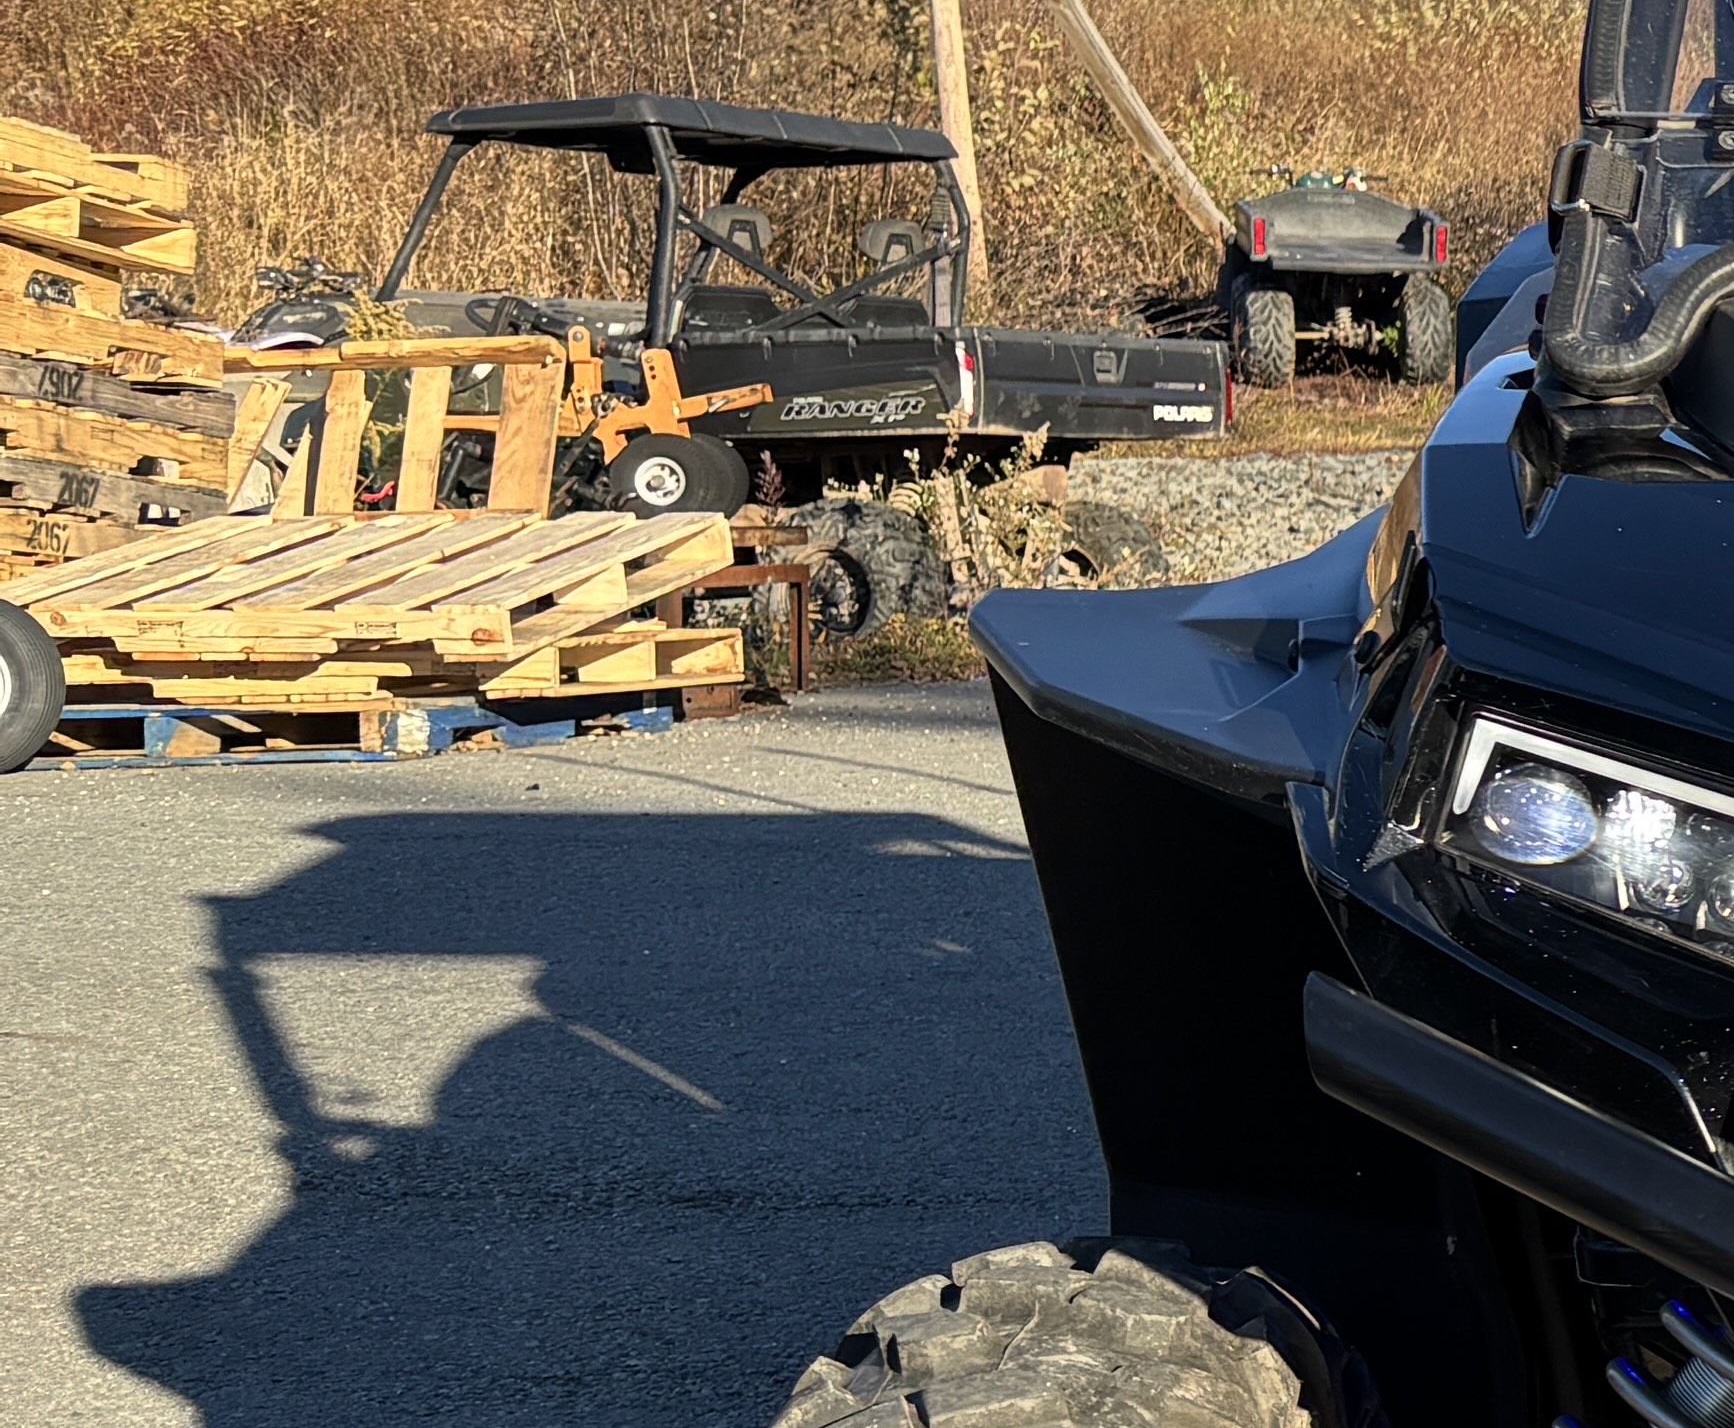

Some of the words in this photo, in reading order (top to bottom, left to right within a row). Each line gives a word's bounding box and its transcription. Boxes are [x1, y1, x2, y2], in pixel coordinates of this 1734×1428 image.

[781, 397, 926, 420] RANGER
[1153, 404, 1214, 422] POLARIS
[58, 472, 100, 508] 2067
[26, 519, 71, 555] 2067
